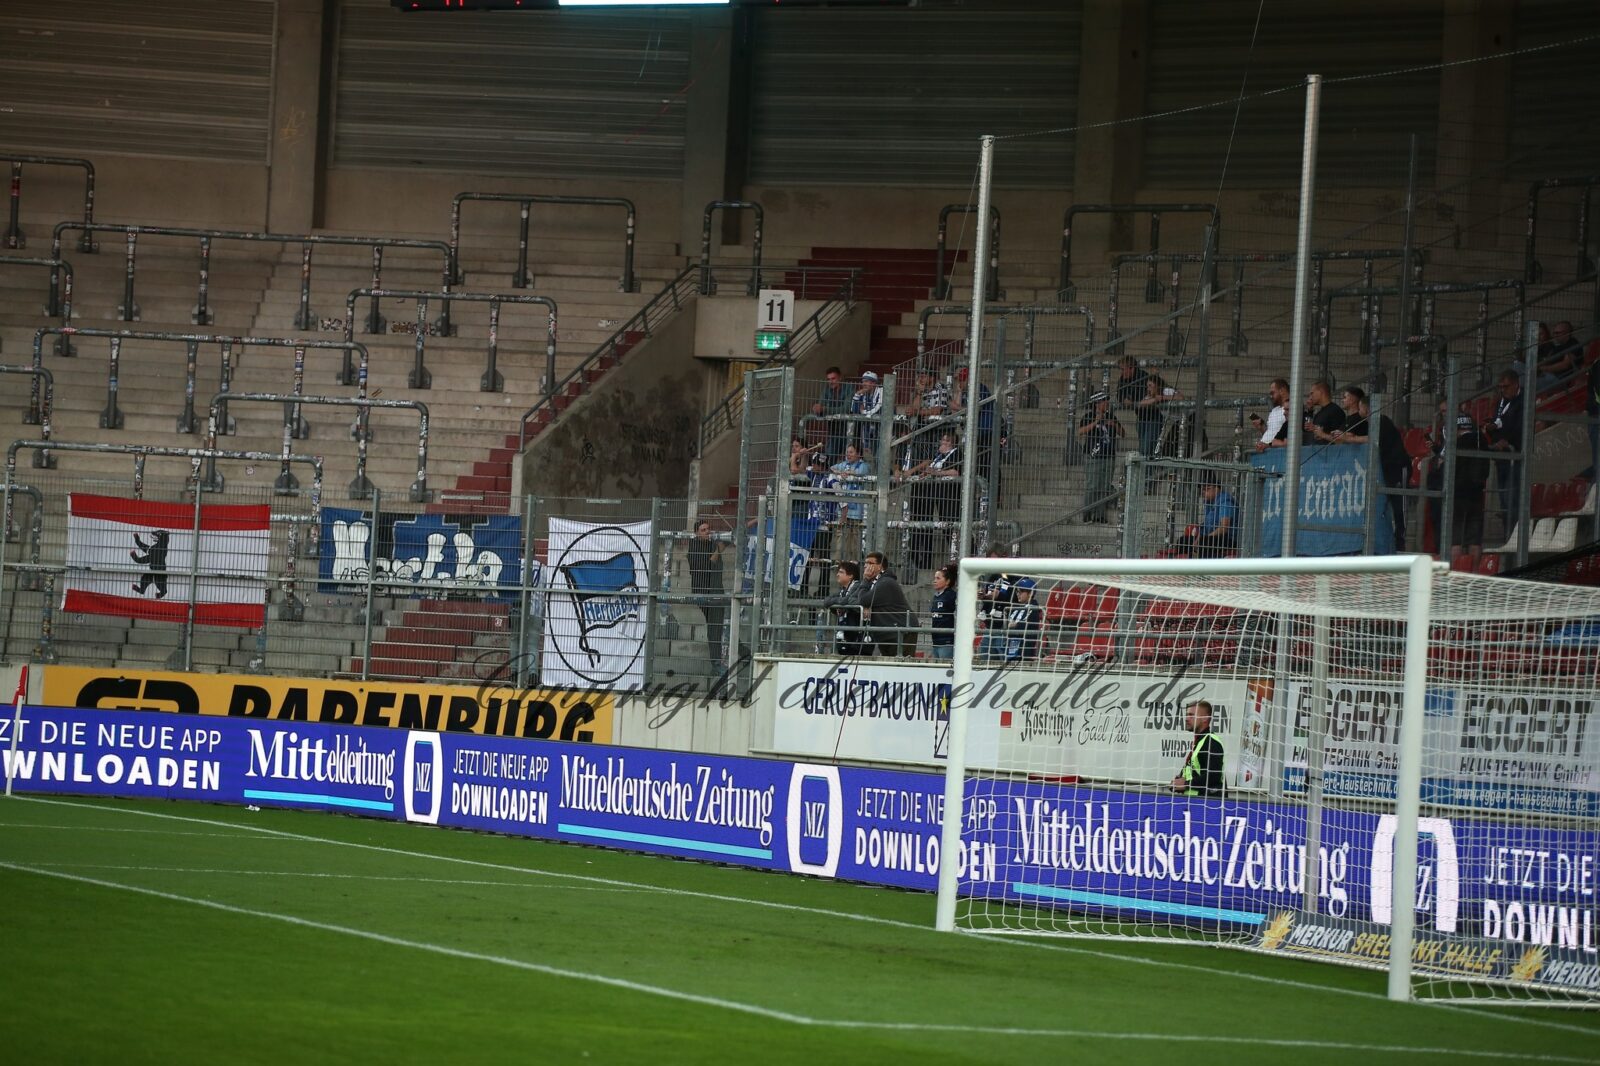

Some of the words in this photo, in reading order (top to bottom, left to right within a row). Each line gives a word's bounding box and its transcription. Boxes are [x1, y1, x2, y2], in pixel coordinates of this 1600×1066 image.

[766, 299, 785, 322] 11
[41, 720, 87, 746] DIE
[97, 723, 175, 751] NEUE
[179, 728, 222, 754] APP
[1144, 701, 1232, 734] ZUSAEN
[1460, 693, 1594, 757] EGGERT
[415, 762, 431, 793] MZ
[453, 748, 481, 776] JETZT
[482, 751, 499, 778] DIE
[500, 753, 527, 780] NEUE
[528, 755, 550, 782] APP
[1375, 750, 1399, 770] Gmb
[451, 781, 549, 825] DOWNLOADEN
[558, 754, 692, 823] Mitteldeutsche
[694, 765, 776, 847] Zeitung
[803, 802, 826, 839] MZ
[856, 786, 897, 820] JETZT
[900, 791, 923, 823] DIE
[967, 797, 997, 831] APP
[855, 827, 997, 883] DOWNLODEN
[1013, 797, 1218, 887] Mitteldeutsche
[1484, 846, 1550, 890] JETZT
[1556, 853, 1593, 896] DIE
[1290, 922, 1354, 952] MERKUR
[1440, 943, 1503, 972] HALLE
[1483, 898, 1598, 953] DOWNL
